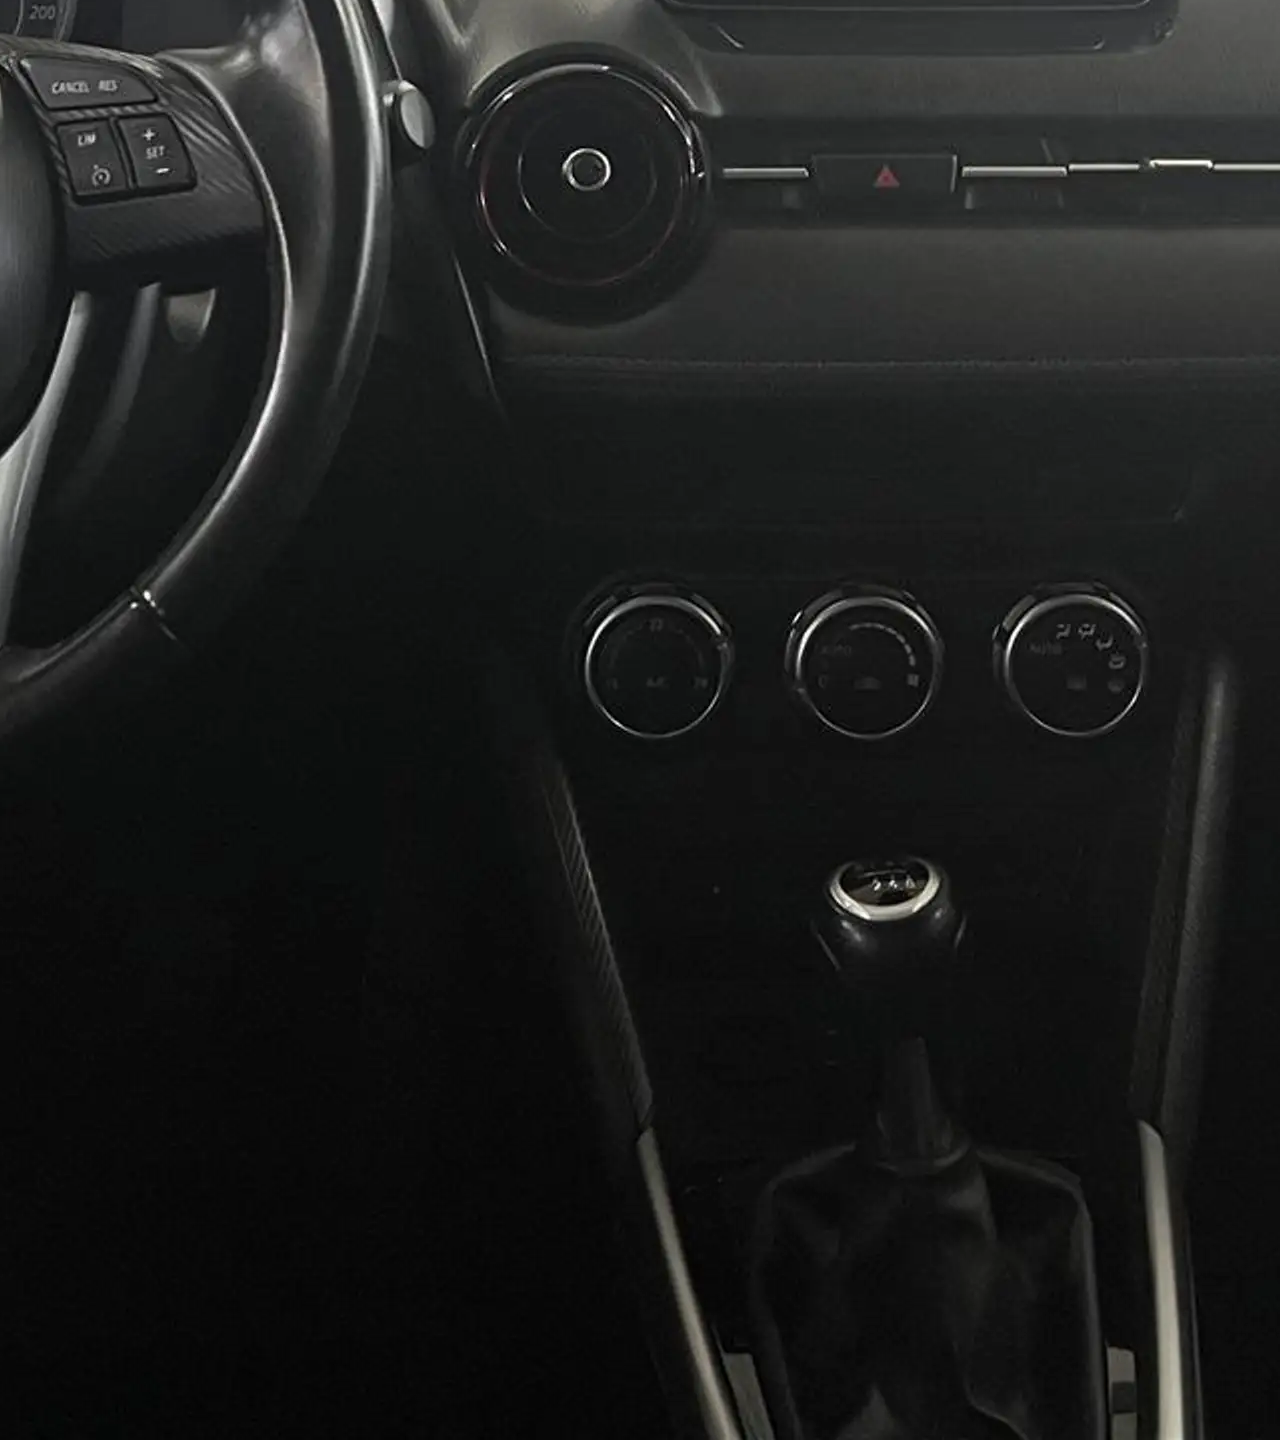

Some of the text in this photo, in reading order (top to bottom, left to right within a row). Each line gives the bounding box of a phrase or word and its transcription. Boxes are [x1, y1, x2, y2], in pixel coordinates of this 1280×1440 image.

[28, 5, 56, 20] 200
[51, 80, 118, 95] CANCEL RES
[146, 145, 166, 159] SET
